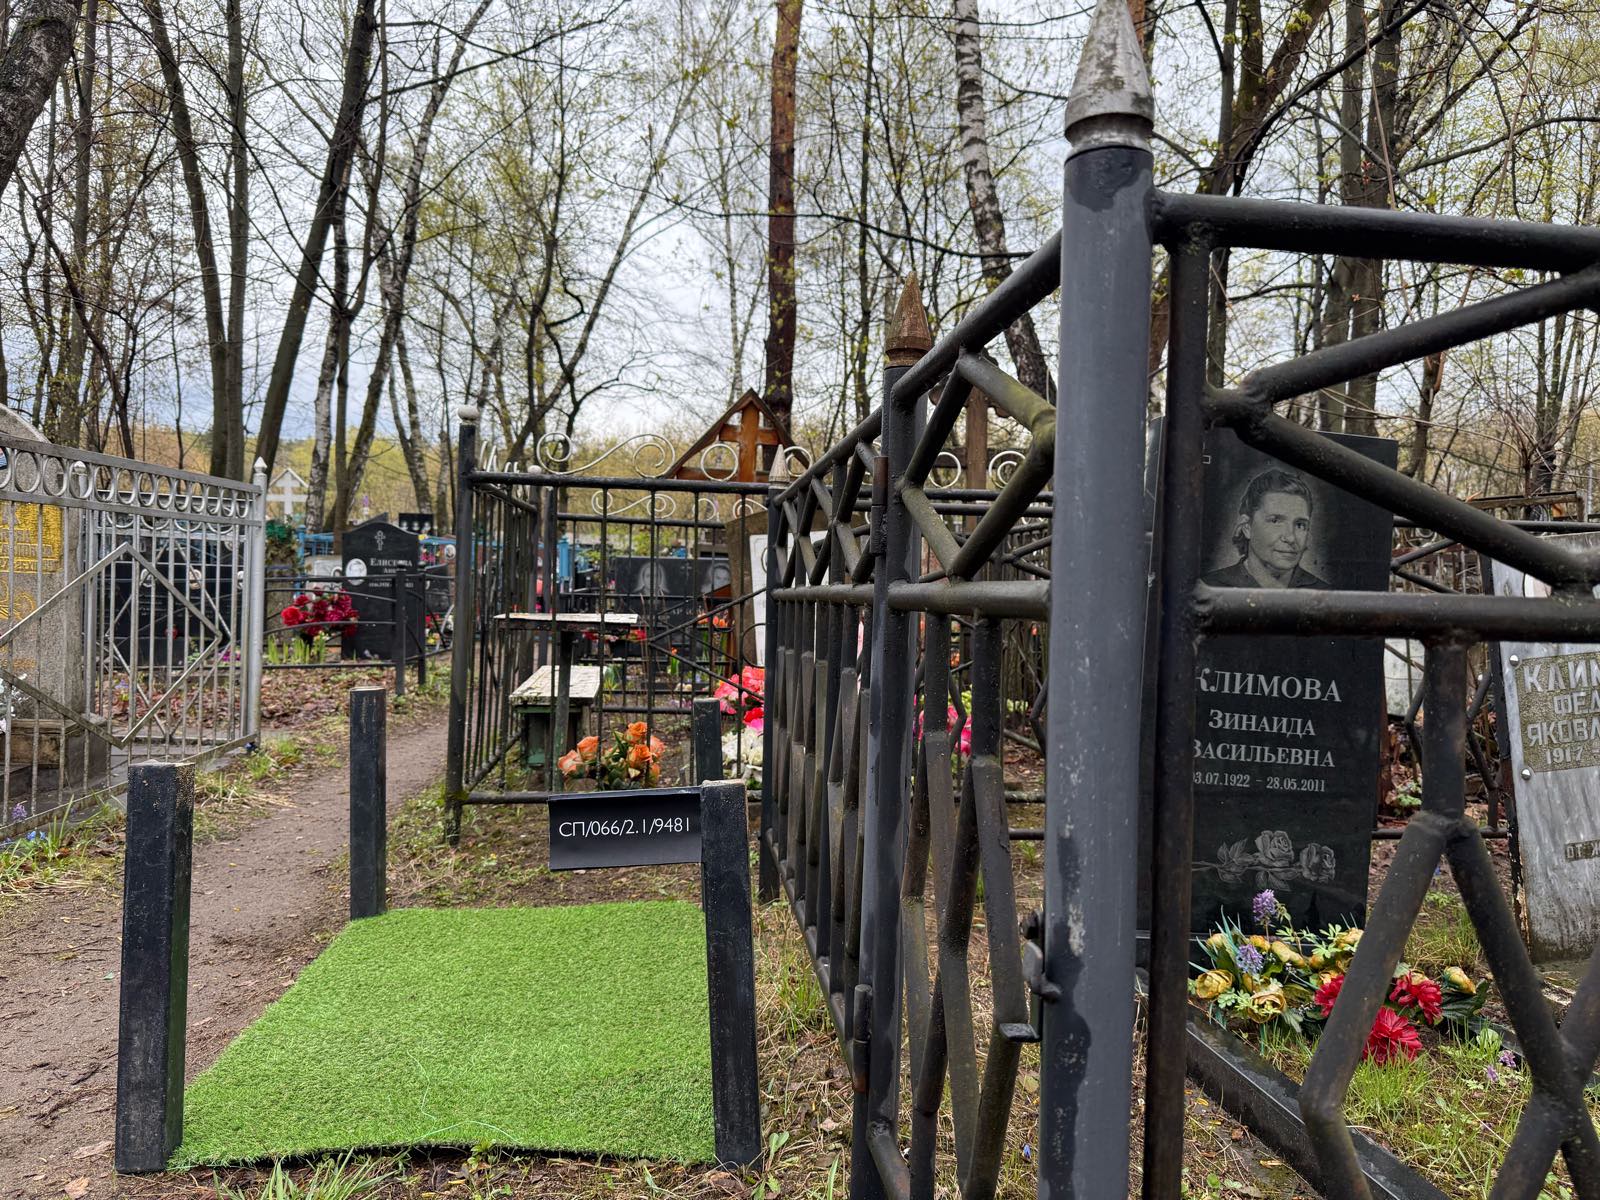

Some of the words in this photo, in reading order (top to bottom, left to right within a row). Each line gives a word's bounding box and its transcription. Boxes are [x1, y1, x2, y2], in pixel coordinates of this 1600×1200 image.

[1208, 709, 1316, 739] ЗИНАИДА
[1545, 745, 1583, 766] 1917
[1193, 771, 1250, 788] 3.07.1922
[1266, 776, 1326, 793] 28.05.2011
[558, 817, 690, 838] СП/066/2.1/9481
